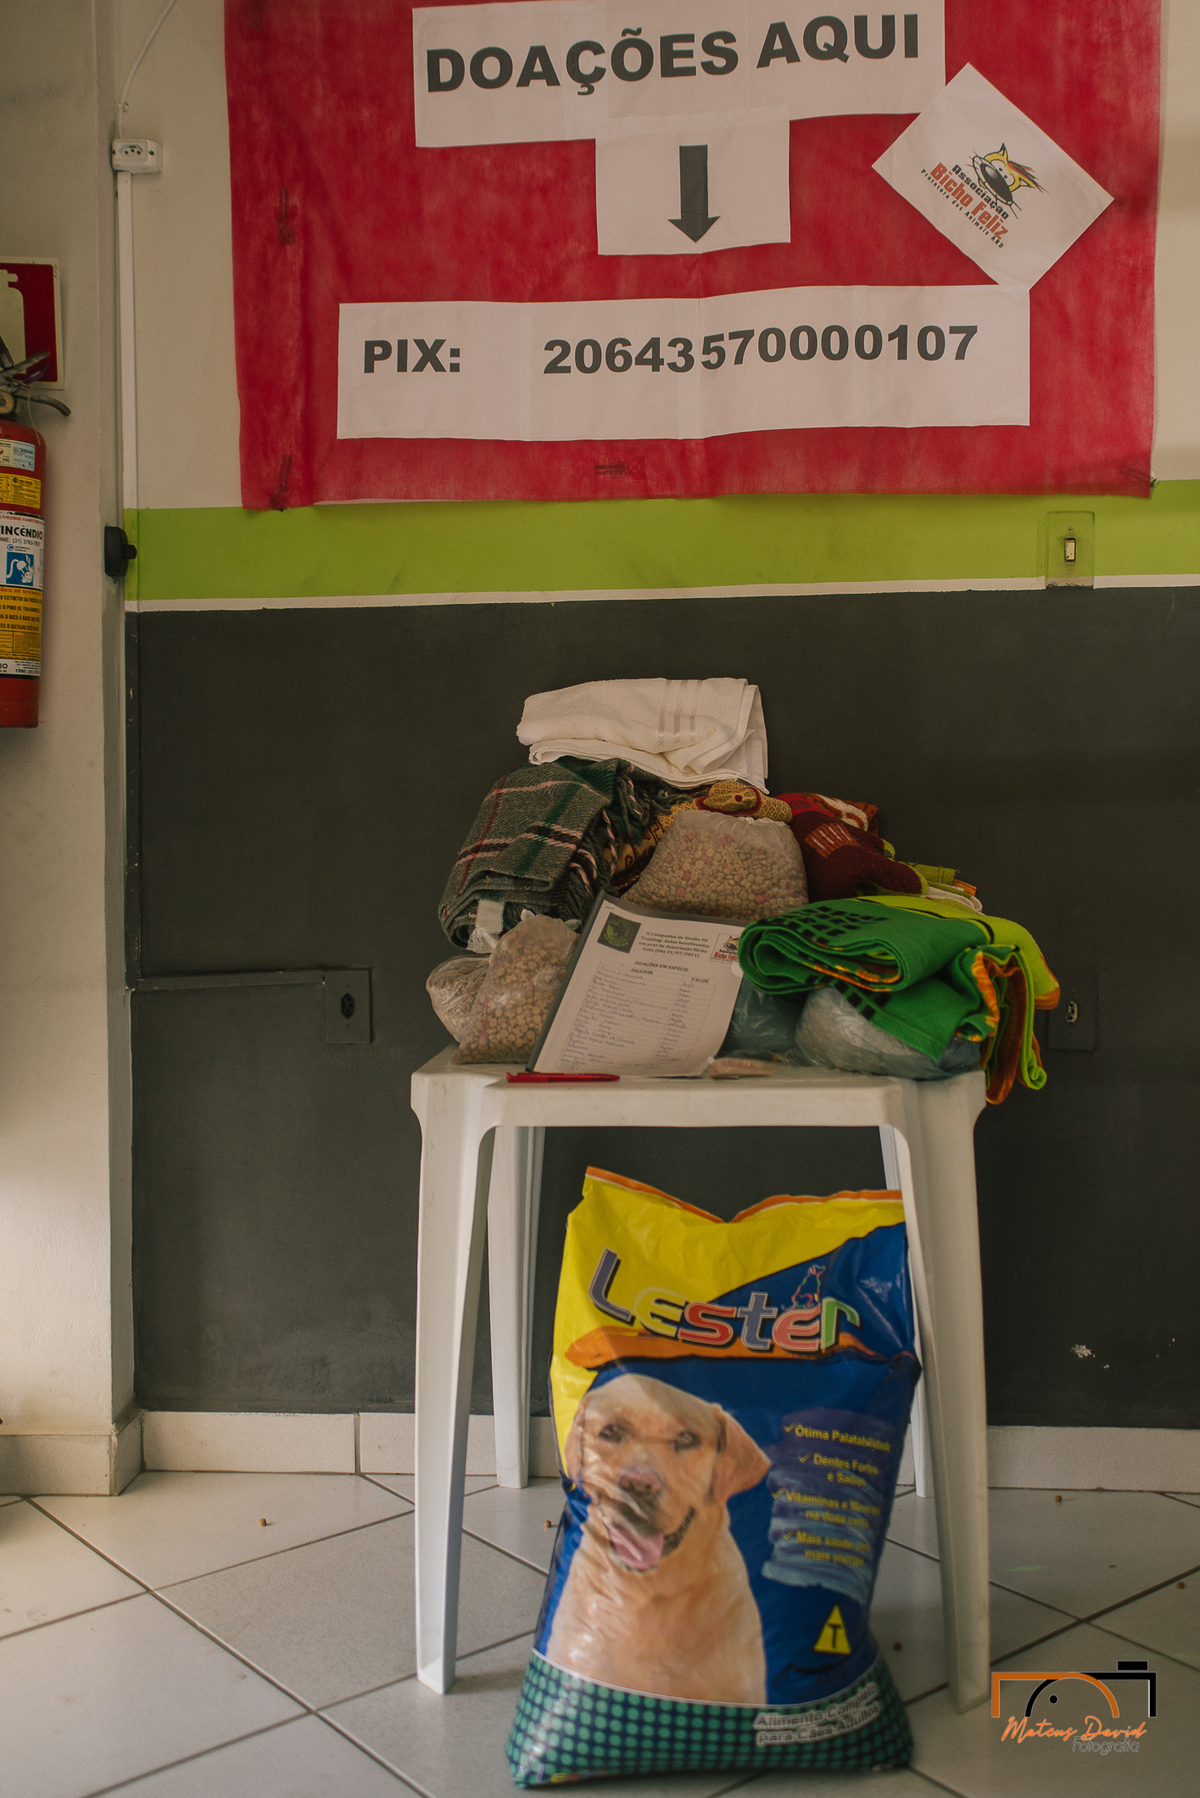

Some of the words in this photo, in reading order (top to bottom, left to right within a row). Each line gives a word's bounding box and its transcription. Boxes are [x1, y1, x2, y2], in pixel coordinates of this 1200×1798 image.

[426, 27, 739, 96] DOAÇÕES
[756, 13, 919, 69] AQUI
[930, 163, 973, 207] Bicho
[971, 200, 1009, 240] Feliz
[951, 164, 1010, 220] Associação
[363, 338, 461, 374] PIX:
[543, 324, 978, 375] 20643570000107
[588, 1246, 862, 1353] Lester
[827, 1623, 842, 1648] T
